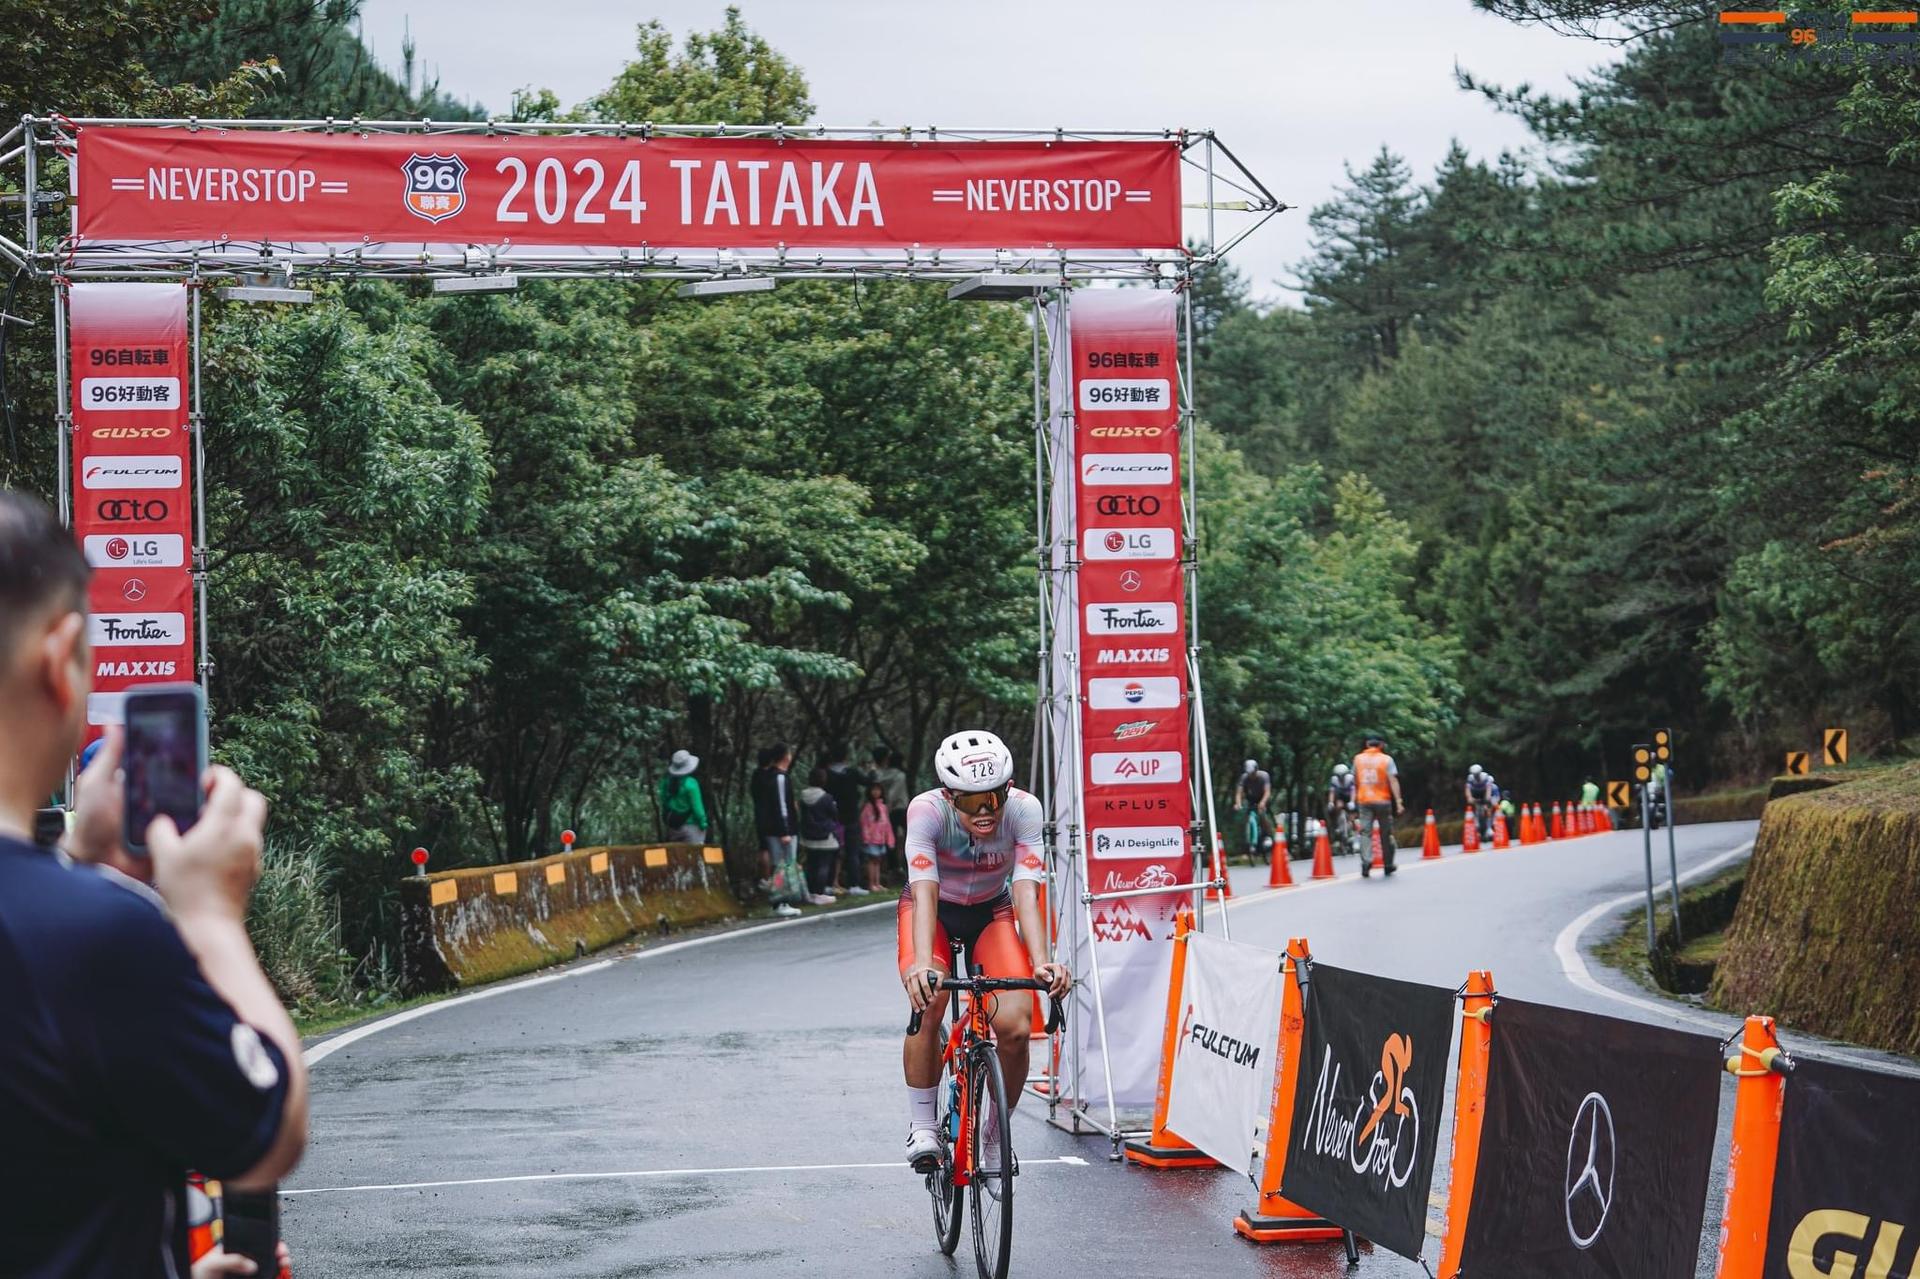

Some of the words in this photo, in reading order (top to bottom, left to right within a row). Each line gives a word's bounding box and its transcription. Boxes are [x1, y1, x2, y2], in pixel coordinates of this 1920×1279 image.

[148, 167, 316, 202] NEVERSTOP
[414, 165, 455, 190] 96
[495, 157, 647, 225] 2024
[670, 159, 885, 227] TATAKA
[966, 179, 1122, 212] NEVERSTOP
[90, 349, 169, 366] 96自転車
[91, 385, 170, 402] 96好動客
[1089, 387, 1160, 403] 96好動客
[92, 428, 171, 438] GUSTO
[1090, 427, 1162, 437] GUSTO
[133, 541, 158, 556] LG
[1129, 534, 1151, 549] LG
[1100, 608, 1164, 630] Frontier
[99, 618, 171, 641] Frontier
[1097, 648, 1170, 664] MAXXIS
[96, 661, 176, 676] MAXXIS
[971, 761, 994, 778] 728
[1141, 759, 1160, 776] UP
[1114, 839, 1125, 848] AI
[1128, 837, 1180, 849] DesignLife
